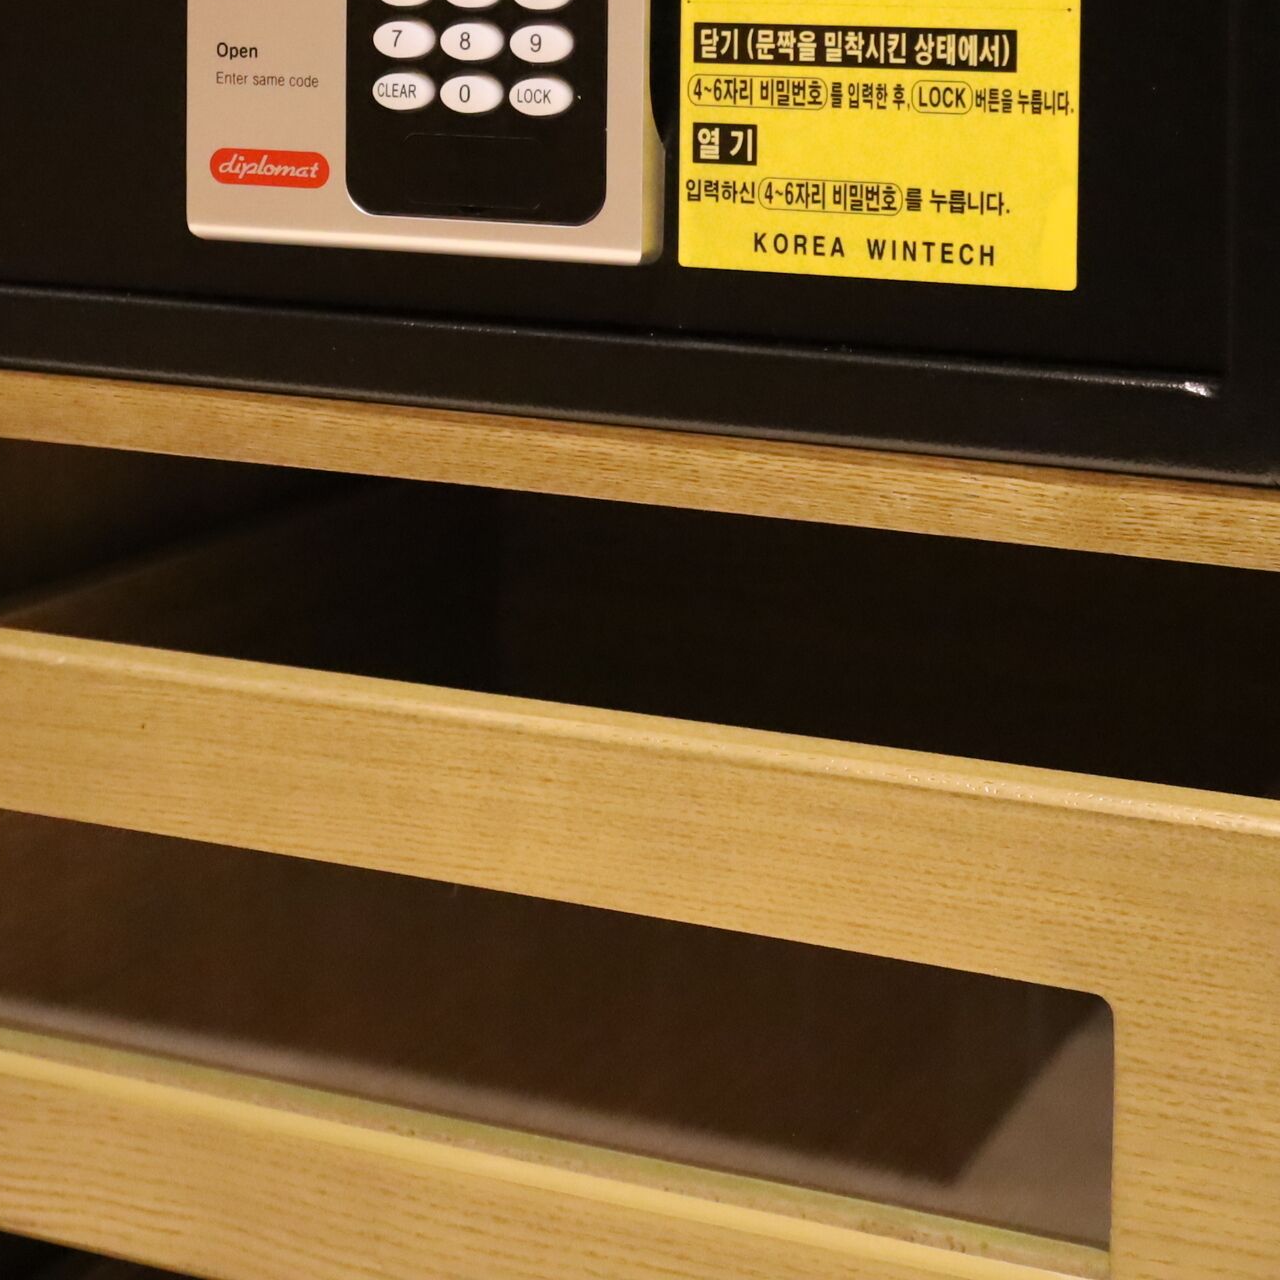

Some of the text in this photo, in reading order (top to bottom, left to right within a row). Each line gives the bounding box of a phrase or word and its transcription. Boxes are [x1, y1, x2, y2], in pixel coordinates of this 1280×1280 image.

[392, 29, 402, 47] 7
[459, 32, 470, 50] 8
[530, 34, 541, 52] 9
[216, 42, 258, 60] Open
[700, 28, 1010, 68] 닫기 (문짝을 밀착시킨 상태에서)
[216, 72, 319, 87] Enter same code
[377, 83, 416, 98] CLEAR
[459, 84, 470, 102] 0
[517, 89, 551, 104] LOCK
[693, 77, 754, 106] 4~6자리
[760, 78, 823, 107] 비밀번호
[830, 82, 842, 108] 를
[848, 82, 888, 110] 입력한
[919, 86, 966, 108] LOCK
[975, 86, 1013, 113] 버튼을
[1017, 89, 1074, 116] 누릅니다.
[219, 154, 319, 179] diplomat
[686, 178, 1010, 216] 입력하신 4~6자리 비밀번호 를 누릅니다.
[754, 232, 995, 267] KOREA WINTECH
